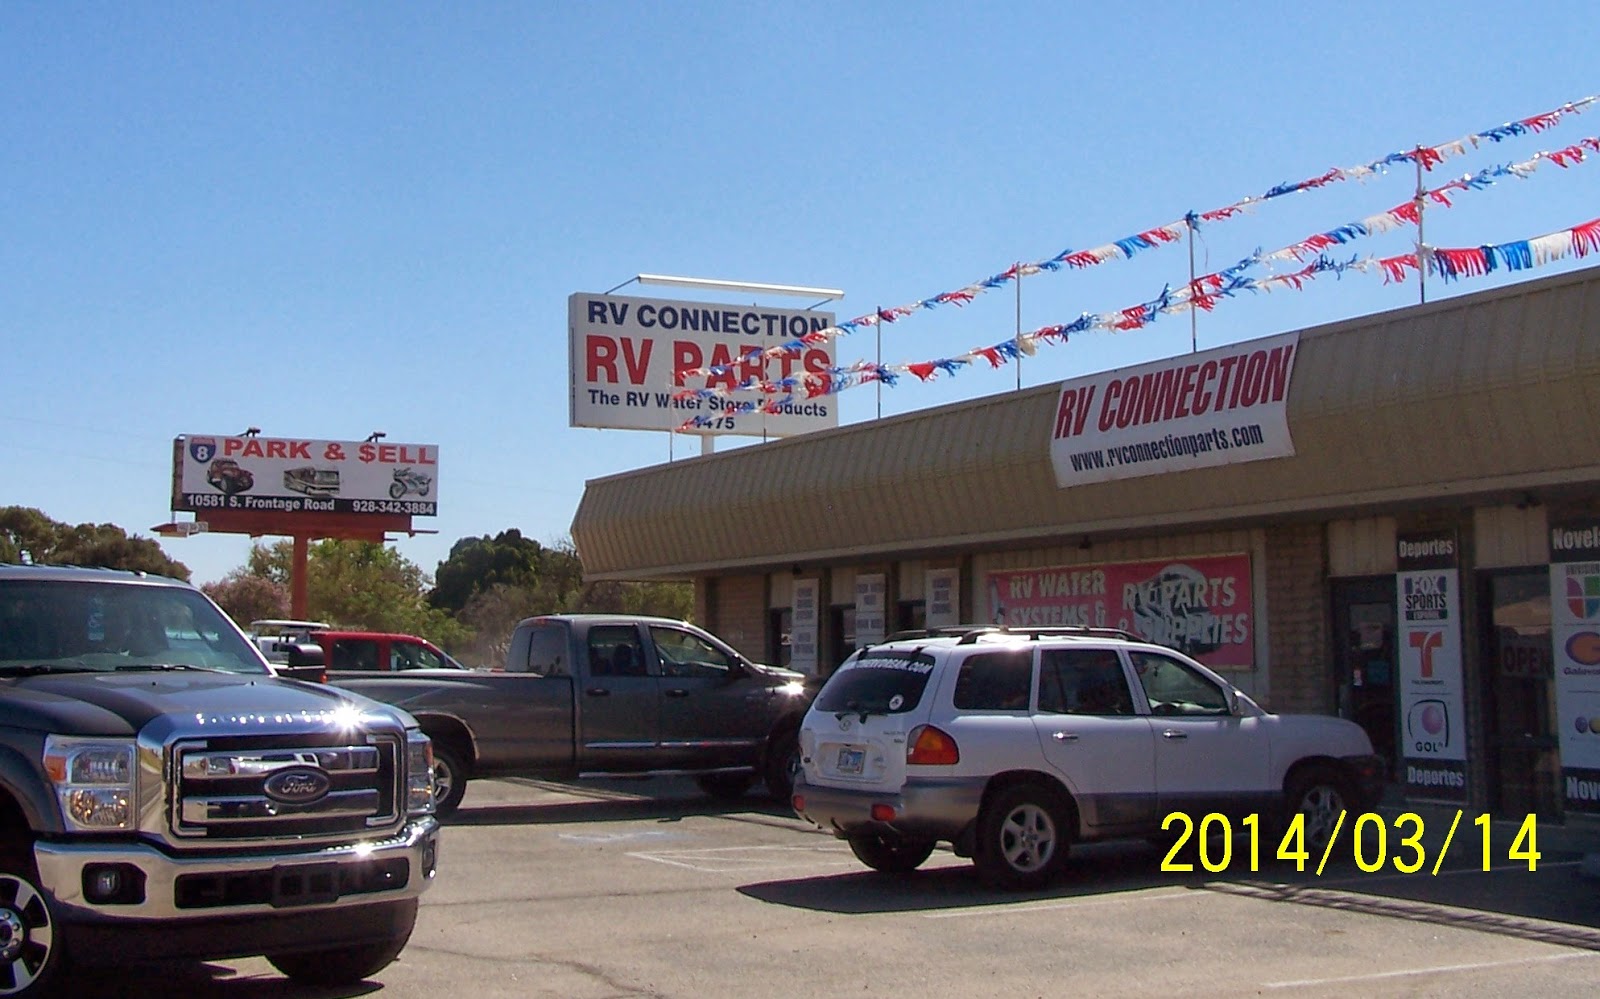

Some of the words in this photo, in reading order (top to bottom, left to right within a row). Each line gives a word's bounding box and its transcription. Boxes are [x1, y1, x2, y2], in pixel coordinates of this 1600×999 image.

[588, 300, 629, 324] RV
[637, 305, 828, 338] CONNECTION
[586, 335, 653, 385] RV
[673, 341, 832, 397] PARTS
[588, 389, 620, 406] The
[627, 392, 650, 407] RV
[1054, 385, 1096, 440] RV
[1098, 344, 1294, 432] CONNECTION
[197, 446, 208, 461] 8
[224, 439, 312, 459] PARK
[323, 443, 346, 461] &
[358, 442, 436, 465] $ELL
[1070, 424, 1264, 472] www.rvconnectionparts.com
[188, 495, 225, 508] 10581
[228, 496, 242, 509] S.
[245, 496, 300, 511] Frontage
[304, 498, 335, 511] Road
[352, 500, 434, 515] 928-342-3884
[1399, 539, 1453, 559] Deportes
[1009, 576, 1033, 600] RV
[1039, 570, 1107, 598] WATER
[1122, 581, 1158, 611] RV
[1161, 576, 1237, 609] PARTS
[1406, 593, 1446, 609] SPORTS
[1010, 604, 1089, 626] SYSTEMS
[281, 774, 317, 793] Ford
[1407, 766, 1464, 787] Deportes
